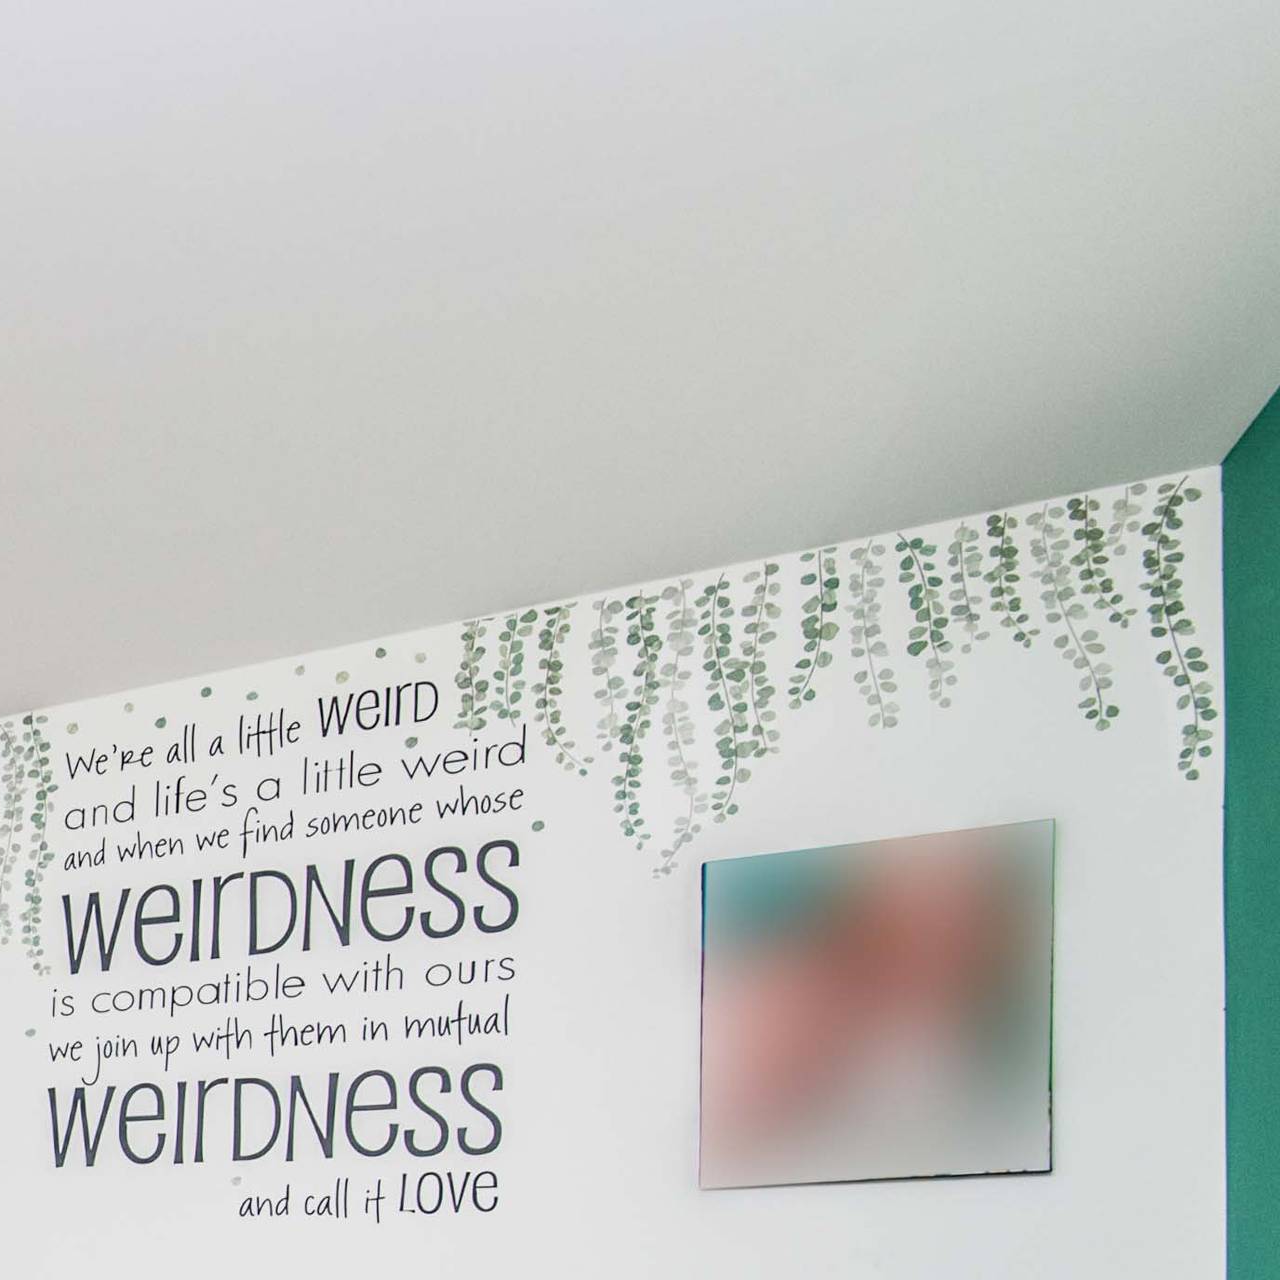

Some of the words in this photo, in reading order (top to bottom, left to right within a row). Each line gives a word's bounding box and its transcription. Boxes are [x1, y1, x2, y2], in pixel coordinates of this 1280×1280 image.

[65, 785, 135, 830] and
[156, 774, 237, 817] life's
[257, 778, 280, 801] a
[304, 756, 382, 795] little
[401, 723, 526, 780] weird
[66, 744, 153, 779] We're
[167, 723, 195, 764] all
[209, 736, 224, 756] a
[239, 708, 301, 757] little
[64, 837, 105, 871] and
[117, 831, 183, 862] when
[196, 829, 229, 851] we
[240, 807, 294, 859] find
[306, 803, 423, 837] someone
[436, 785, 524, 819] whose
[52, 989, 74, 1017] is
[92, 963, 305, 1017] compatible
[322, 953, 403, 994] with
[425, 957, 515, 986] ours
[49, 1041, 82, 1062] we
[80, 1035, 138, 1086] join
[151, 1036, 180, 1072] up
[193, 1020, 252, 1060] with
[264, 1014, 346, 1057] them
[363, 1017, 388, 1041] in
[405, 993, 509, 1037] mutual
[239, 1184, 289, 1217] and
[305, 1178, 348, 1218] call
[365, 1179, 385, 1224] it
